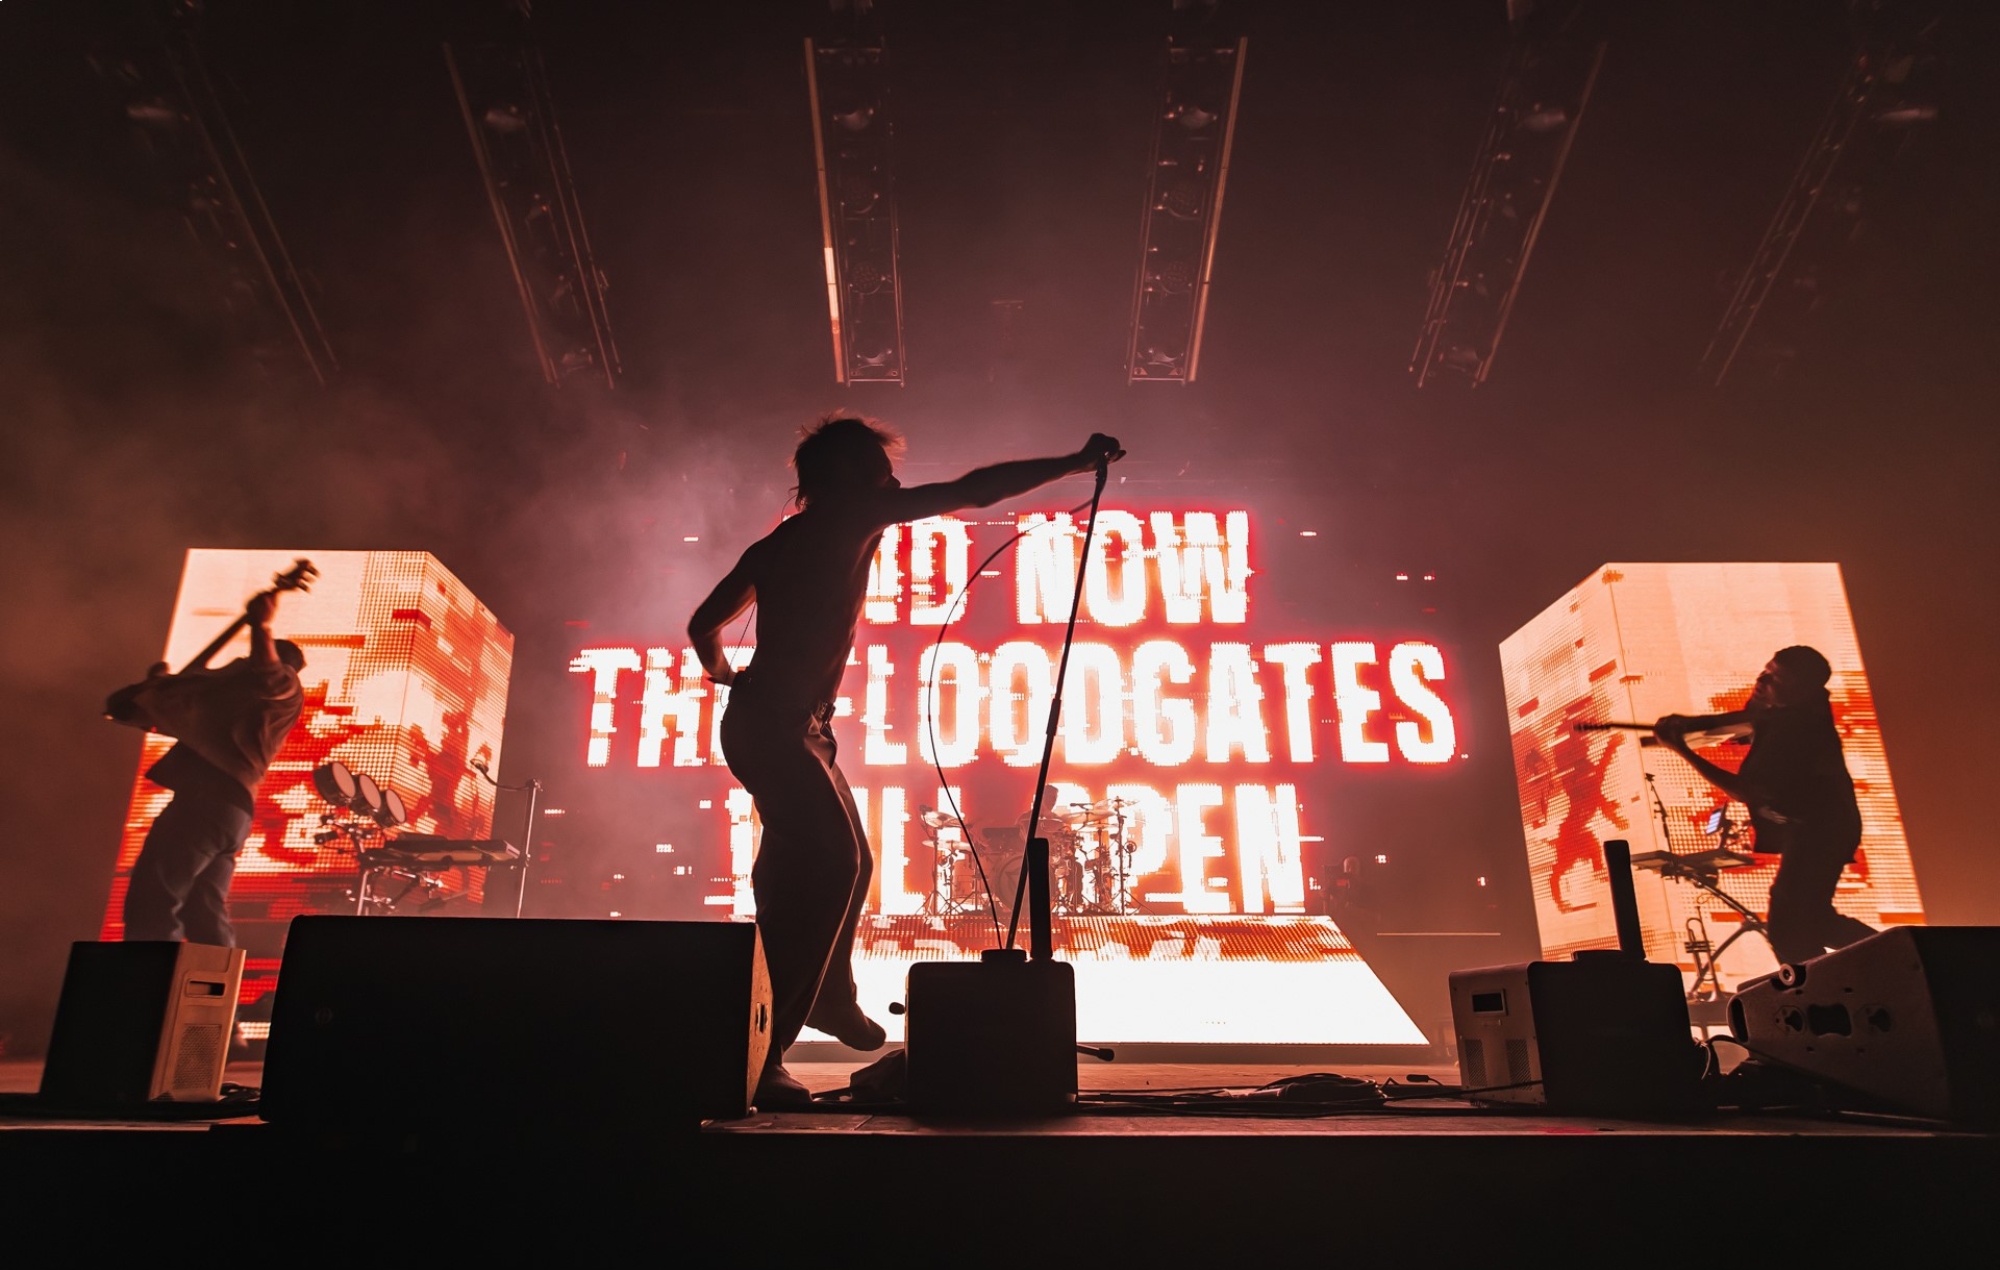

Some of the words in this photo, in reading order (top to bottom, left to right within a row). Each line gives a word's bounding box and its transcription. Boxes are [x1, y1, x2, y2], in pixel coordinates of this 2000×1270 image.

[864, 513, 968, 625] ND
[1017, 510, 1250, 626] NOW
[834, 640, 1456, 767] LOODGATES
[728, 786, 978, 915] LL
